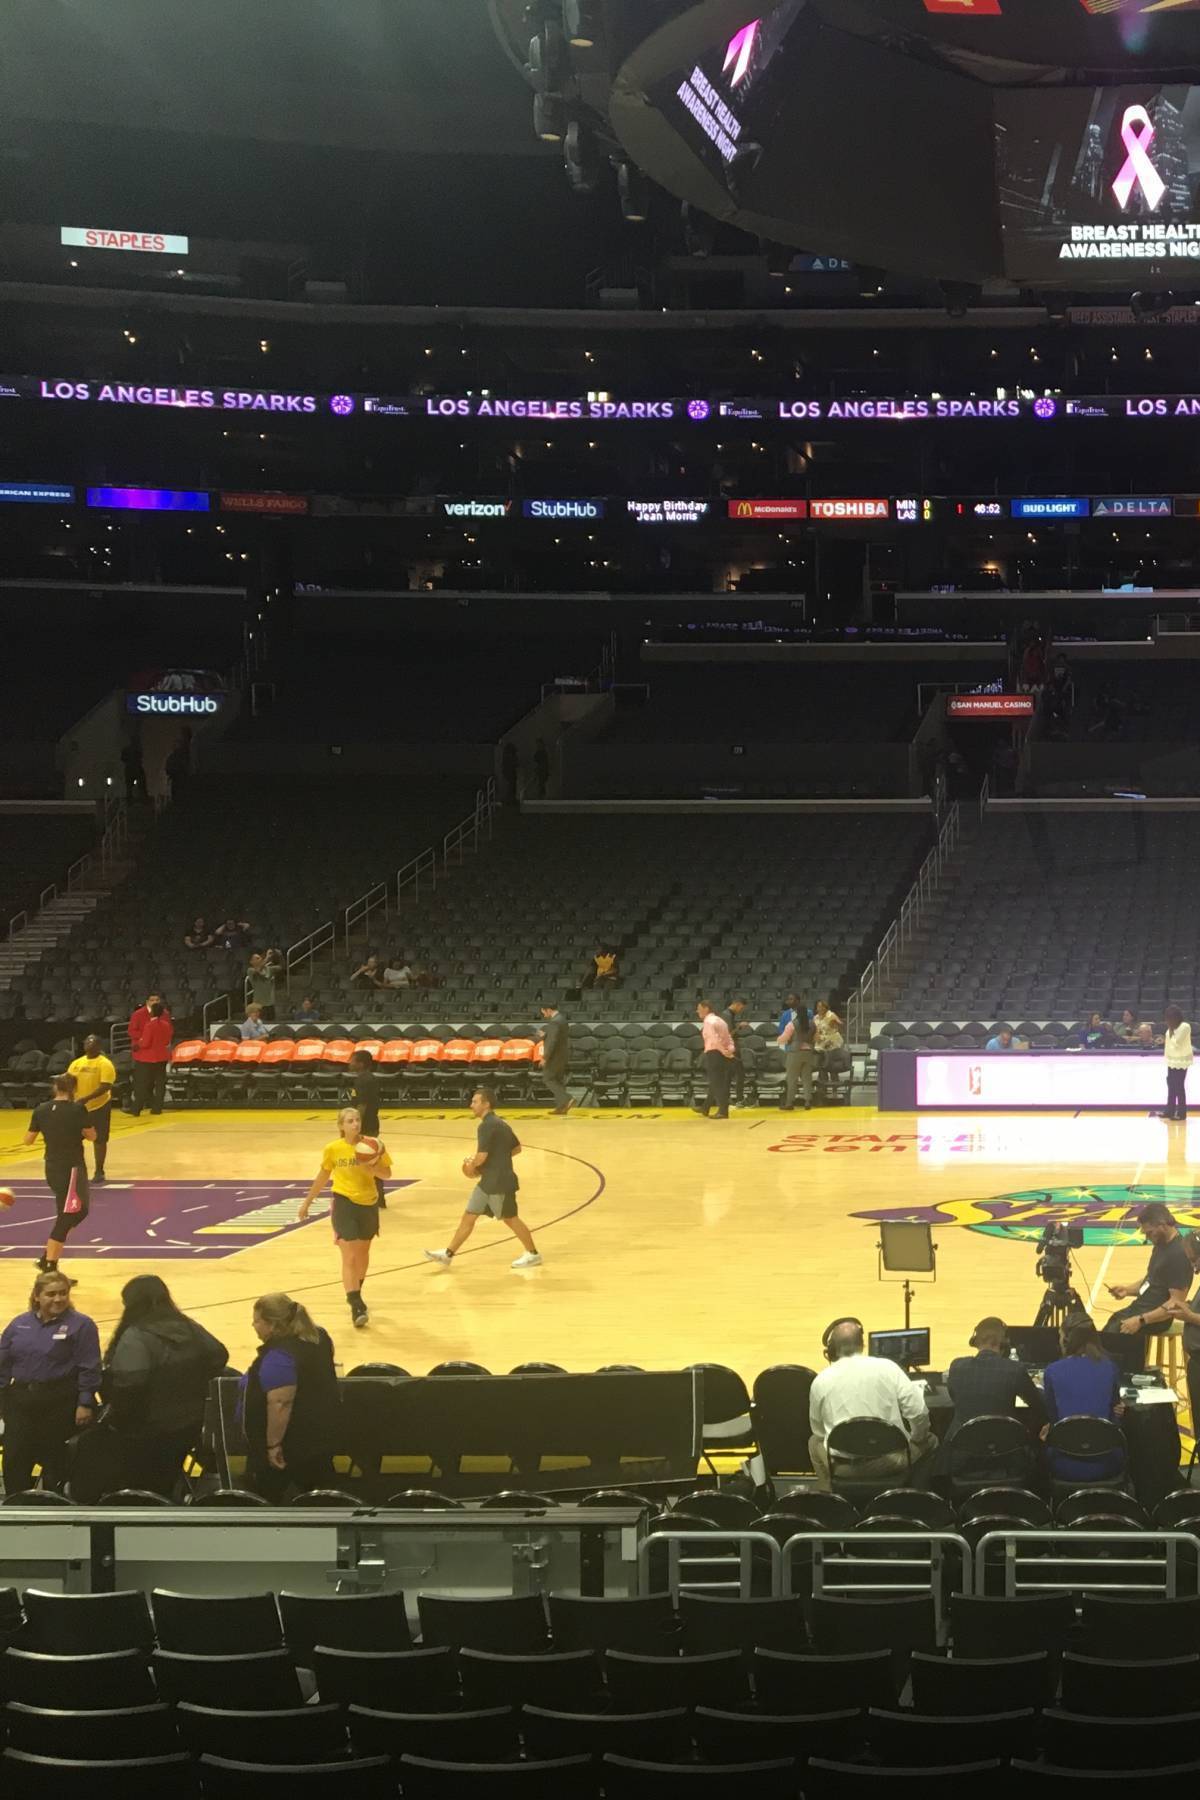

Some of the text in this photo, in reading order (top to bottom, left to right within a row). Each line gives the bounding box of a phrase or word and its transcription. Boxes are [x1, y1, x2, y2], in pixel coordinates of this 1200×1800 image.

[1071, 225, 1138, 240] BREAST
[85, 231, 165, 250] STAPLES
[1059, 242, 1166, 258] AWARENESS
[40, 381, 316, 413] LOS ANGELES SPARKS
[427, 399, 673, 419] LOS ANGELES SPARKS
[779, 400, 1020, 418] LOS ANGELES SPARKS
[1126, 399, 1167, 416] LOS
[33, 490, 71, 498] EXPRESS
[222, 497, 308, 509] WELLS FARGO
[444, 501, 505, 516] verizon
[531, 501, 597, 517] StubHub
[627, 500, 708, 513] Happy Birthday
[754, 505, 798, 514] McDonald's
[812, 502, 887, 516] TOSHIBA
[896, 500, 930, 510] MIN 0
[1023, 504, 1077, 513] BUD LIGHT
[1113, 501, 1169, 513] DELTA
[636, 511, 698, 521] Jean Morris
[897, 510, 930, 520] LAS 0
[137, 695, 217, 712] StubHub
[957, 701, 1032, 709] SAN MANUEL CASINO
